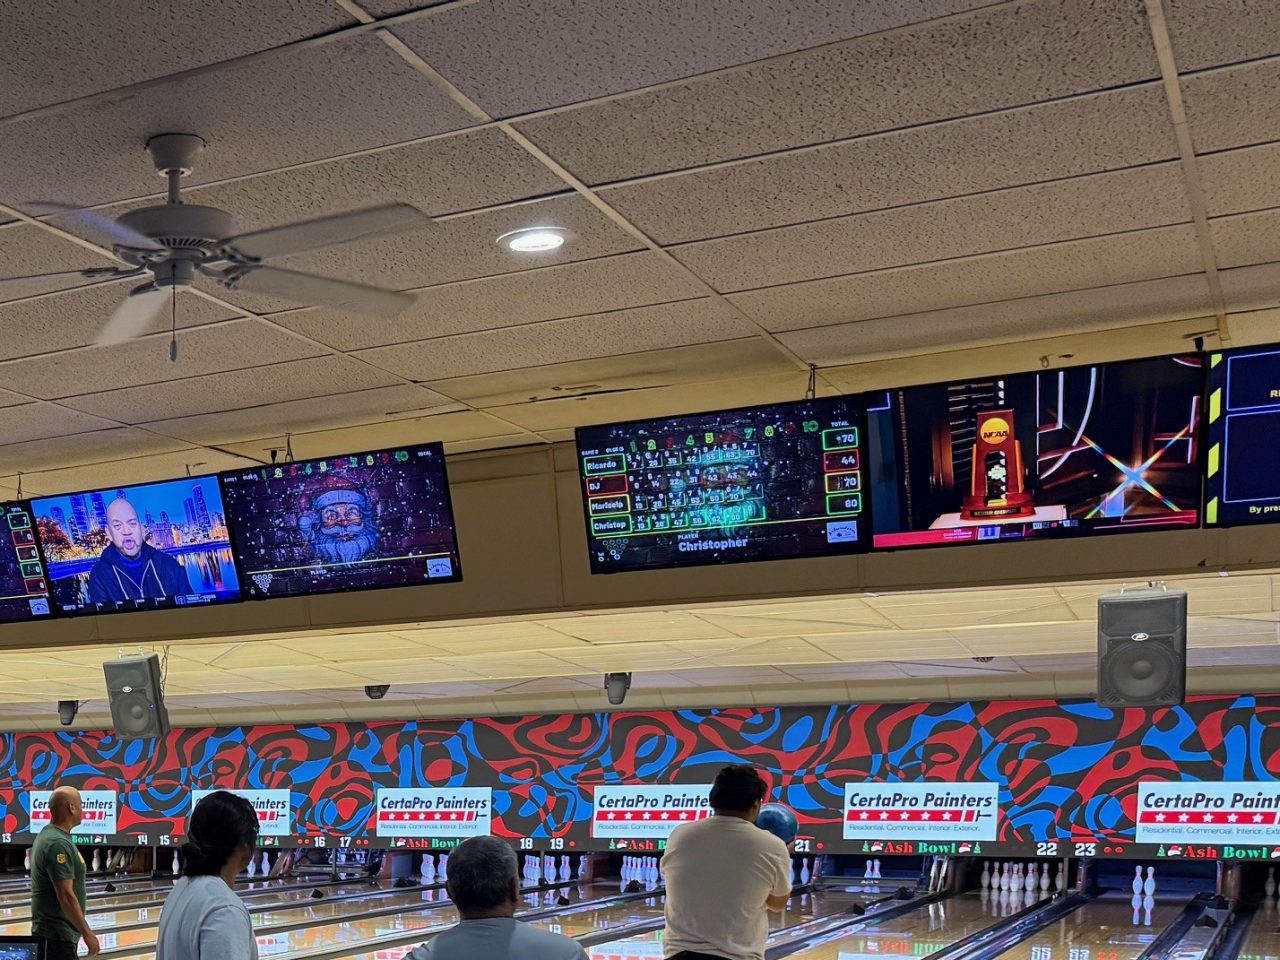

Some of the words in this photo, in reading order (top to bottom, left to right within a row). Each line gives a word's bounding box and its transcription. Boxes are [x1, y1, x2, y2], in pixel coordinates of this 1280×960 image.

[744, 428, 753, 440] 7
[802, 421, 819, 432] 10
[983, 430, 1009, 439] NCAA
[841, 433, 854, 443] 70
[587, 460, 617, 470] Ricardo
[589, 482, 601, 491] DJ
[843, 477, 857, 487] 70
[1249, 505, 1262, 515] By
[594, 520, 627, 530] Christop
[678, 537, 748, 552] Christopher
[81, 797, 114, 810] ainters
[380, 796, 435, 810] CertaPro
[435, 796, 488, 810] Painters
[598, 794, 659, 809] CertaPro
[849, 792, 919, 808] CertaPro
[923, 791, 992, 808] Painters
[1143, 792, 1225, 809] CertaPro
[1230, 791, 1280, 809] Paint
[2, 833, 12, 843] 13
[71, 834, 93, 844] Bowl
[137, 834, 148, 845] 14
[159, 835, 170, 845] 15
[314, 837, 326, 848] 16
[340, 837, 352, 848] 17
[406, 838, 429, 848] Ash
[520, 838, 533, 850] 18
[549, 838, 564, 850] 19
[628, 839, 654, 850] Ash
[794, 839, 810, 852] 21
[884, 842, 913, 854] Ash
[917, 842, 956, 854] Bowl
[1036, 842, 1058, 856] 22
[1074, 842, 1097, 857] 23
[1183, 846, 1218, 859] Ash
[1222, 846, 1268, 859] Bowl
